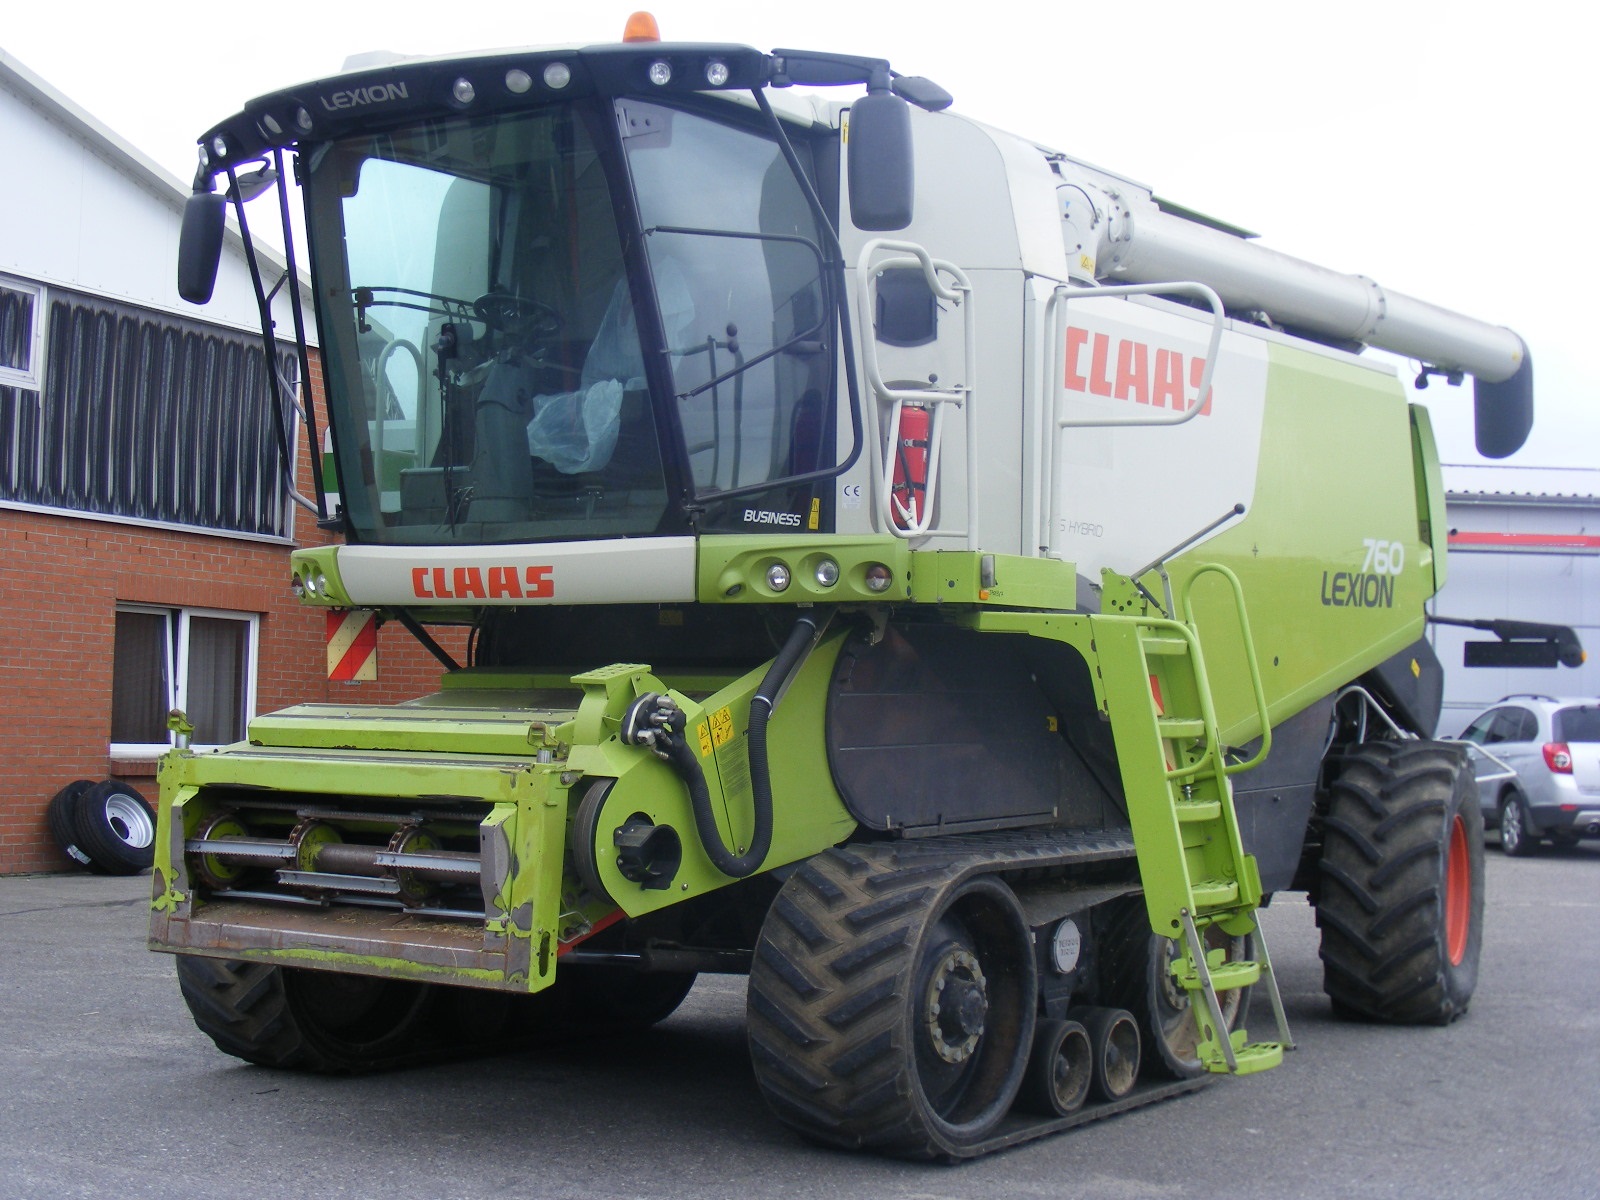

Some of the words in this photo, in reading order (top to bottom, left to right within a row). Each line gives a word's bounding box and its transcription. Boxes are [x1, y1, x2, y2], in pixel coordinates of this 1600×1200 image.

[320, 82, 409, 111] LEXION
[1064, 325, 1213, 417] CLAAS
[743, 509, 802, 527] BUSINESS
[1068, 520, 1104, 538] HYBRID
[1361, 537, 1405, 576] 760
[411, 565, 555, 599] CLAAS
[1320, 570, 1395, 609] LEXION
